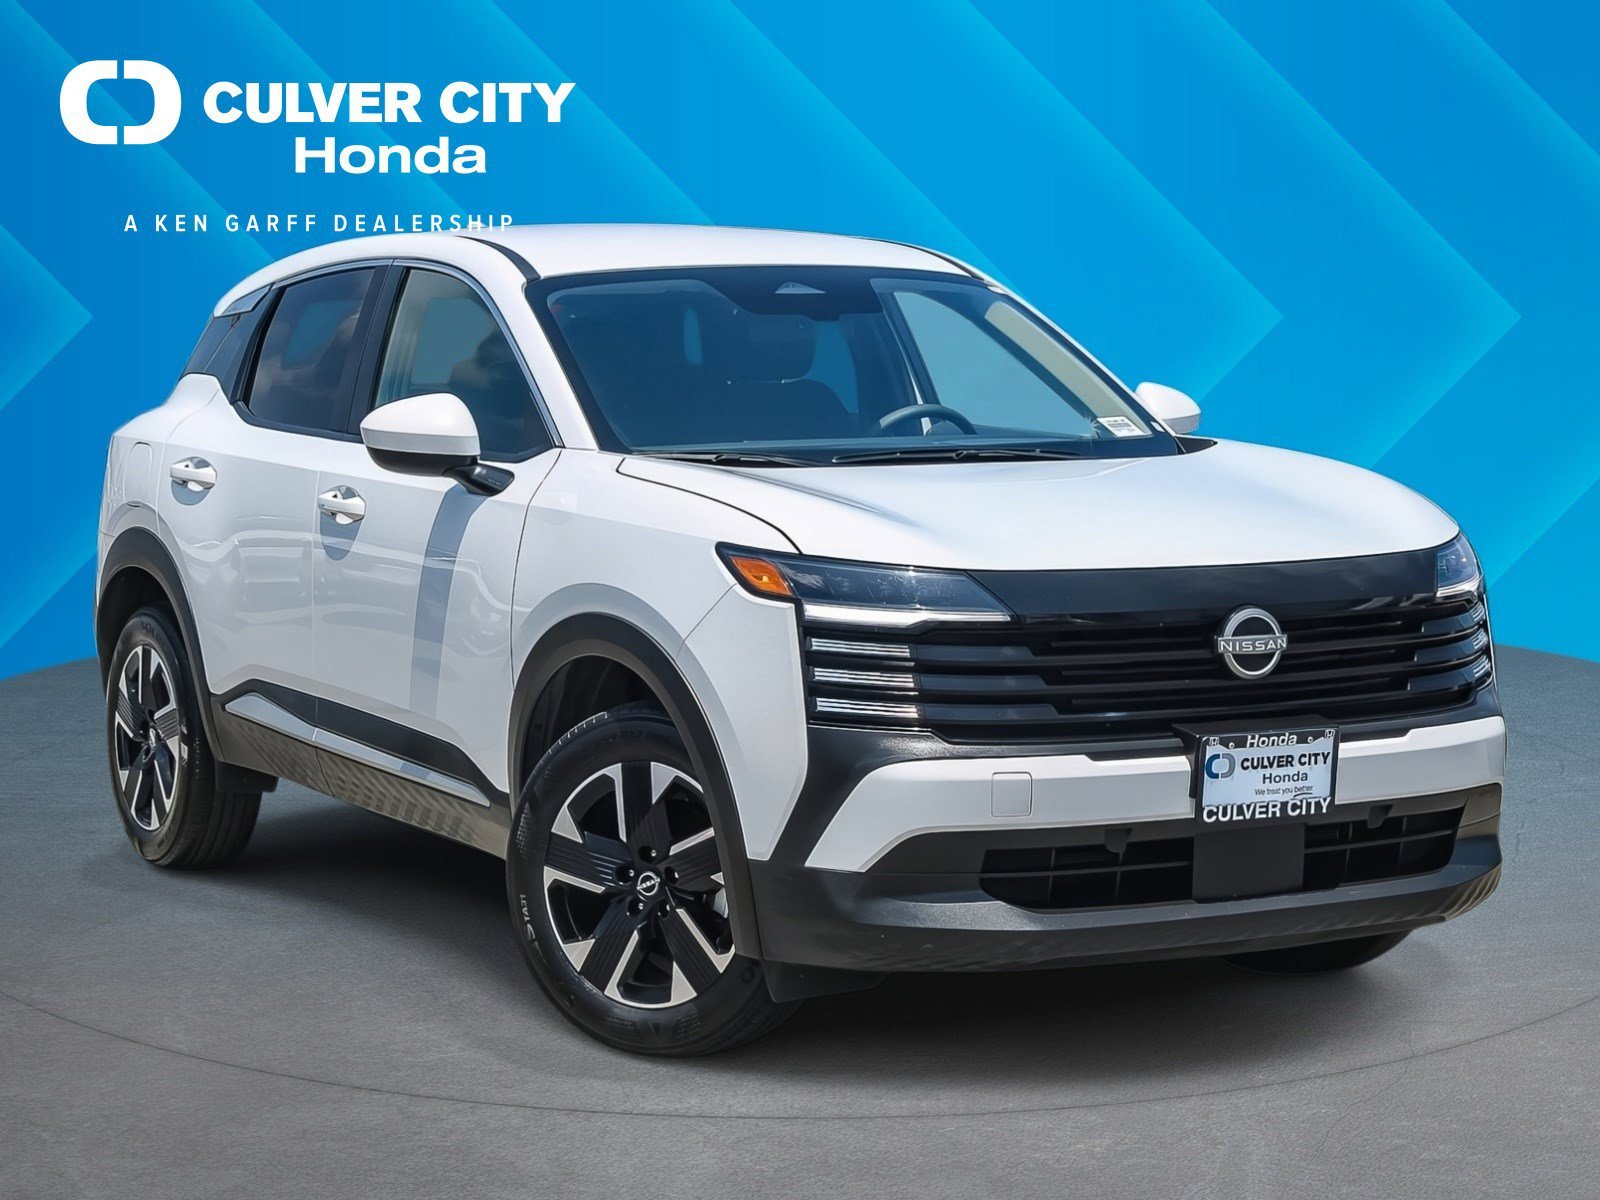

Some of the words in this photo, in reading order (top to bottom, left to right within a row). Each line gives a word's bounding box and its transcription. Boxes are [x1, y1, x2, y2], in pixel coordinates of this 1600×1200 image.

[1220, 638, 1286, 652] NISSAN
[1246, 733, 1297, 748] Honda
[1240, 755, 1294, 771] CULVER
[1298, 751, 1331, 767] CITY
[1262, 771, 1308, 785] Honda
[1254, 787, 1265, 796] We
[1281, 787, 1293, 796] you
[1203, 801, 1281, 823] CULVER
[1287, 796, 1331, 816] CITY
